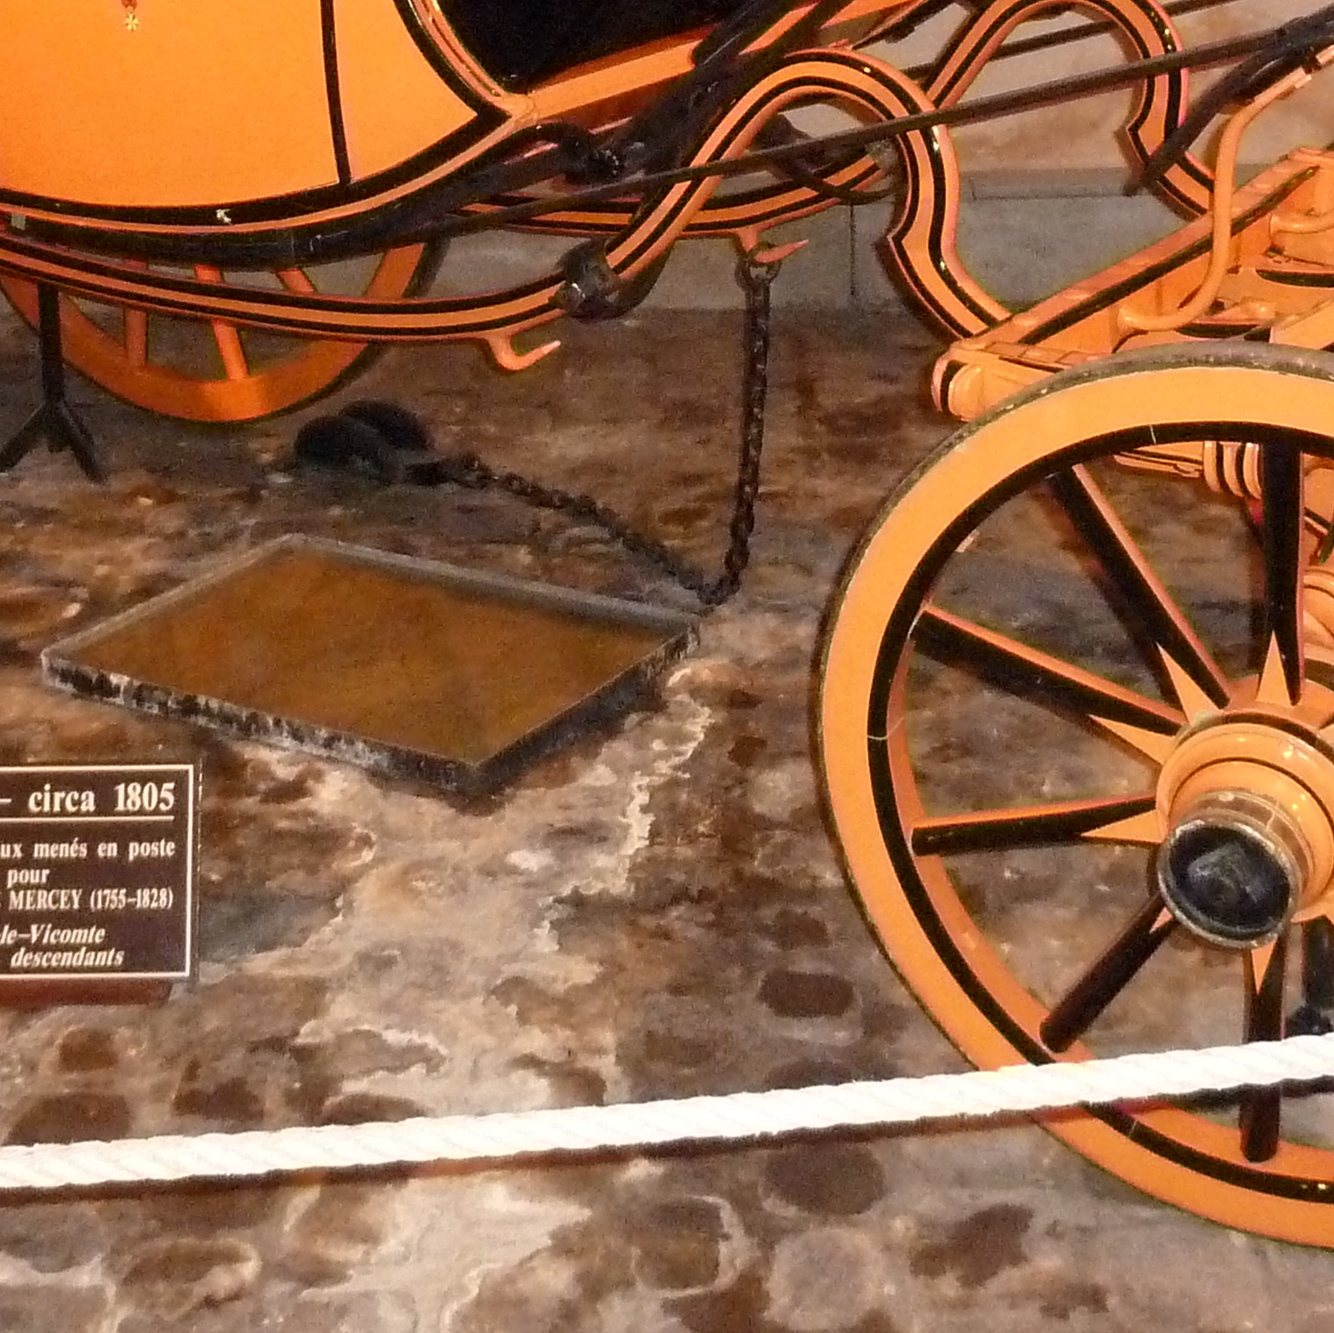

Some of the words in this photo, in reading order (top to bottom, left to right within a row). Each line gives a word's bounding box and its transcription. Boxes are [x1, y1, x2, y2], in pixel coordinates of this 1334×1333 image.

[27, 783, 97, 813] circa
[113, 781, 176, 812] 1805
[32, 837, 89, 859] menés
[97, 841, 119, 858] en
[127, 837, 176, 862] poste
[6, 868, 52, 889] pour
[8, 888, 84, 911] MERCEY
[9, 946, 126, 968] descendants
